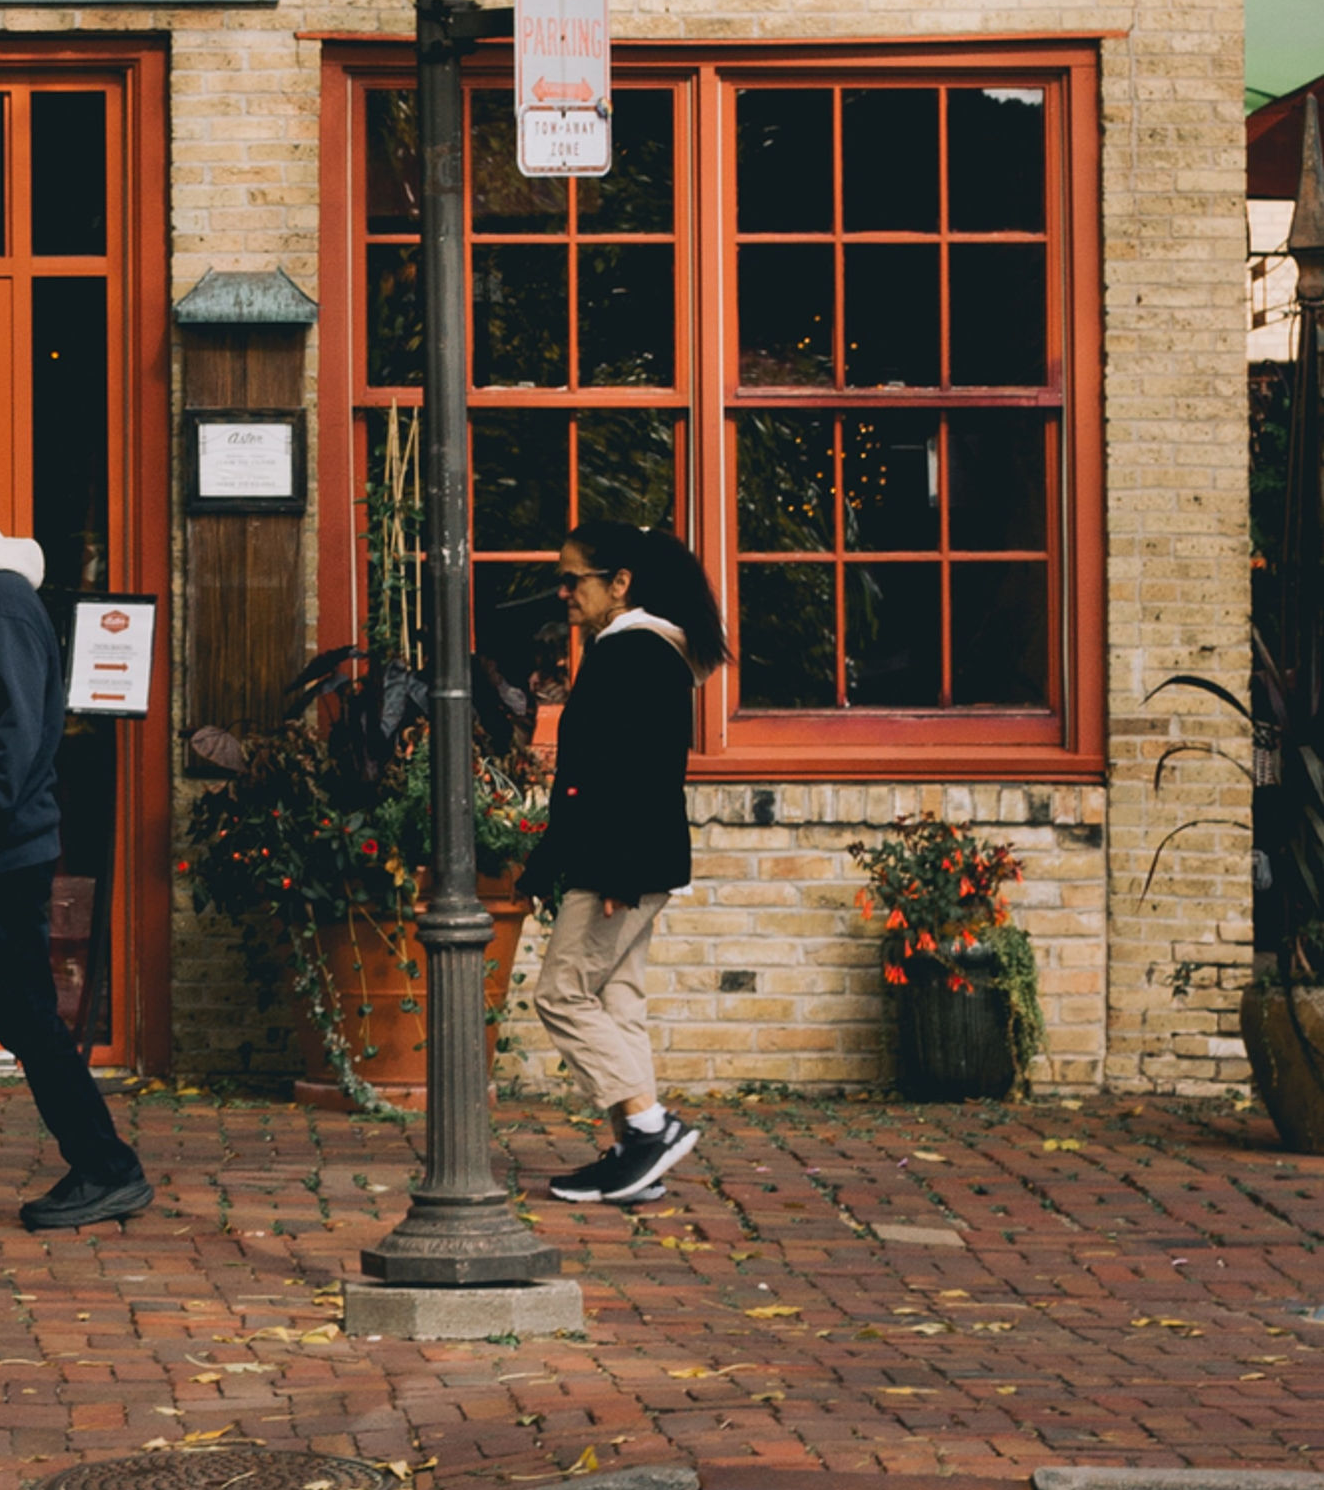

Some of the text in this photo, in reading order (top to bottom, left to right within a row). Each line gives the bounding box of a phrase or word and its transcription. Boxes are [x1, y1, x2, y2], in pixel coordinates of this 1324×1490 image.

[522, 16, 603, 59] PARKING
[534, 121, 596, 135] TOW-AWAY
[551, 141, 580, 156] ZONE
